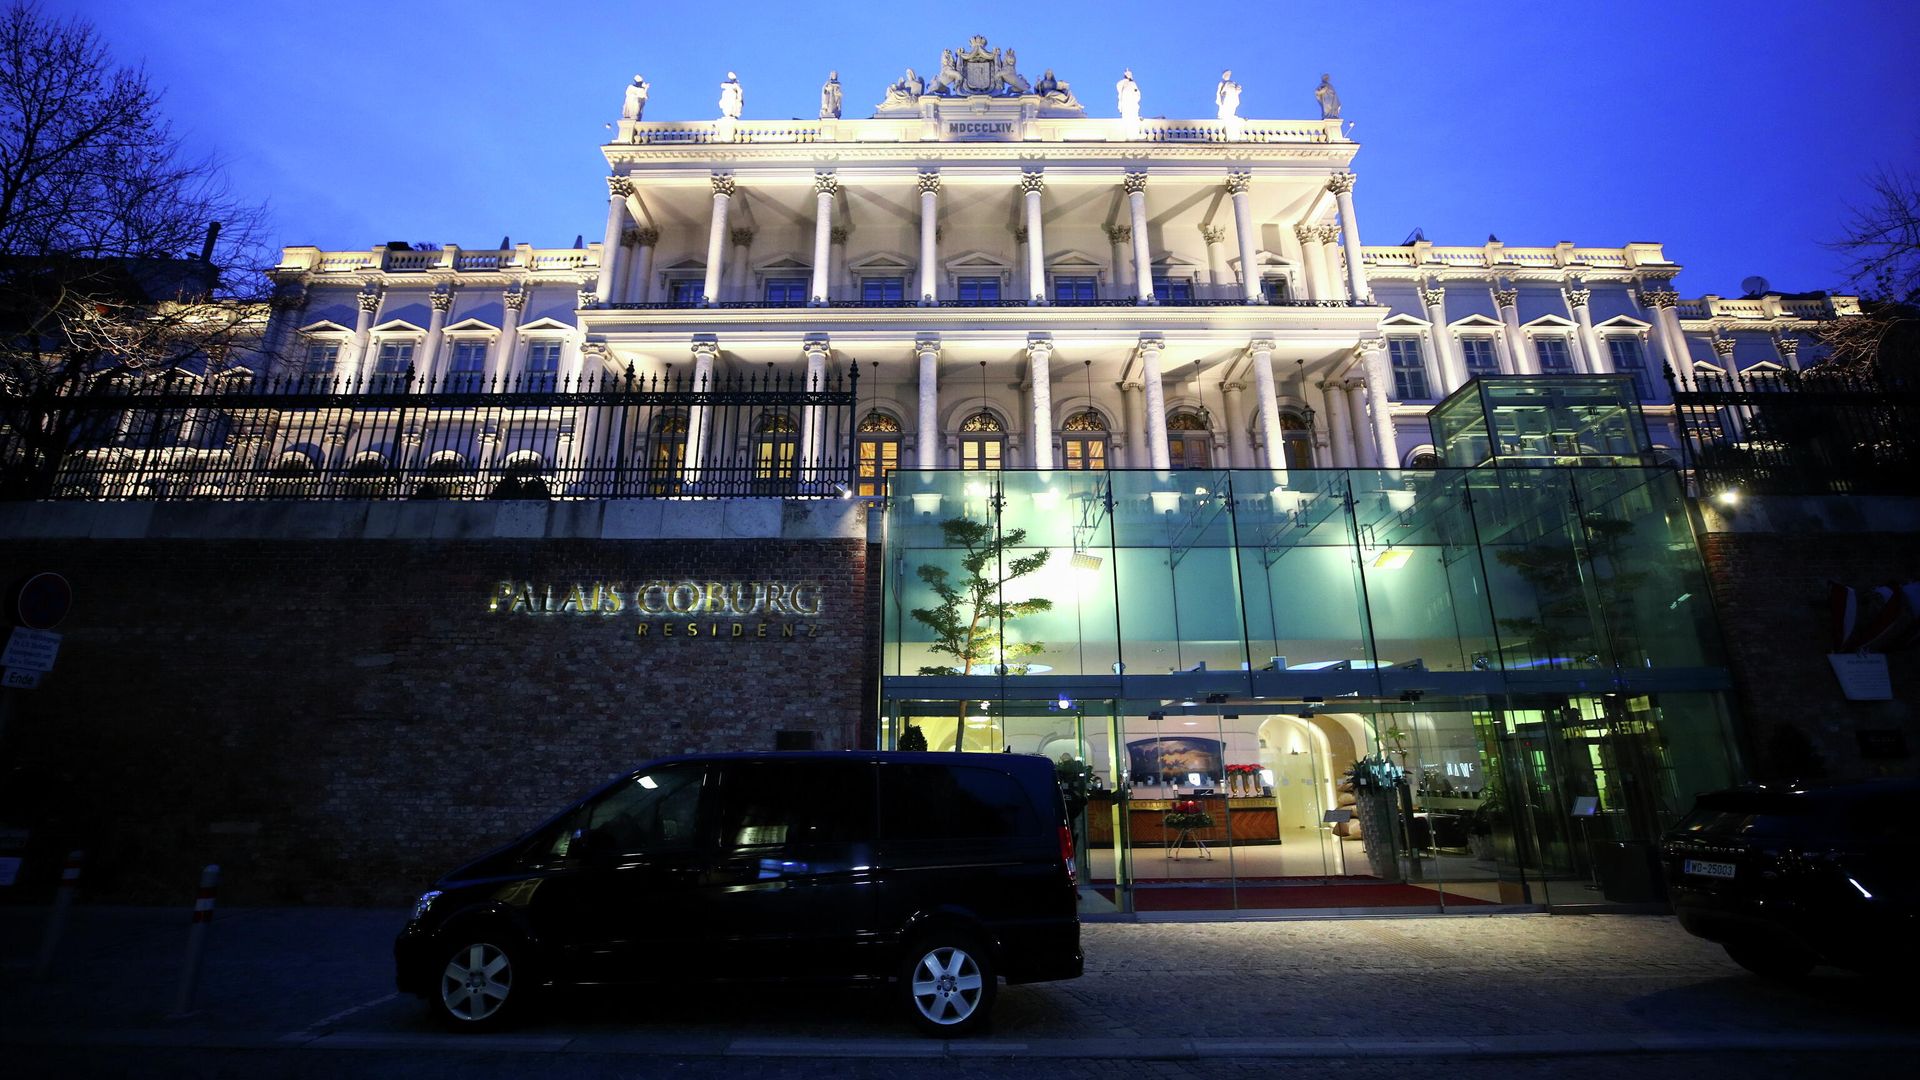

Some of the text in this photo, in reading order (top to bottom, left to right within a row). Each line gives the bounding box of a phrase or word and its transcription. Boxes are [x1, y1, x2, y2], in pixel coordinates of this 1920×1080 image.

[489, 580, 818, 614] PALAIS COBURG
[638, 623, 817, 637] RESIDENZ
[9, 672, 34, 685] Ende
